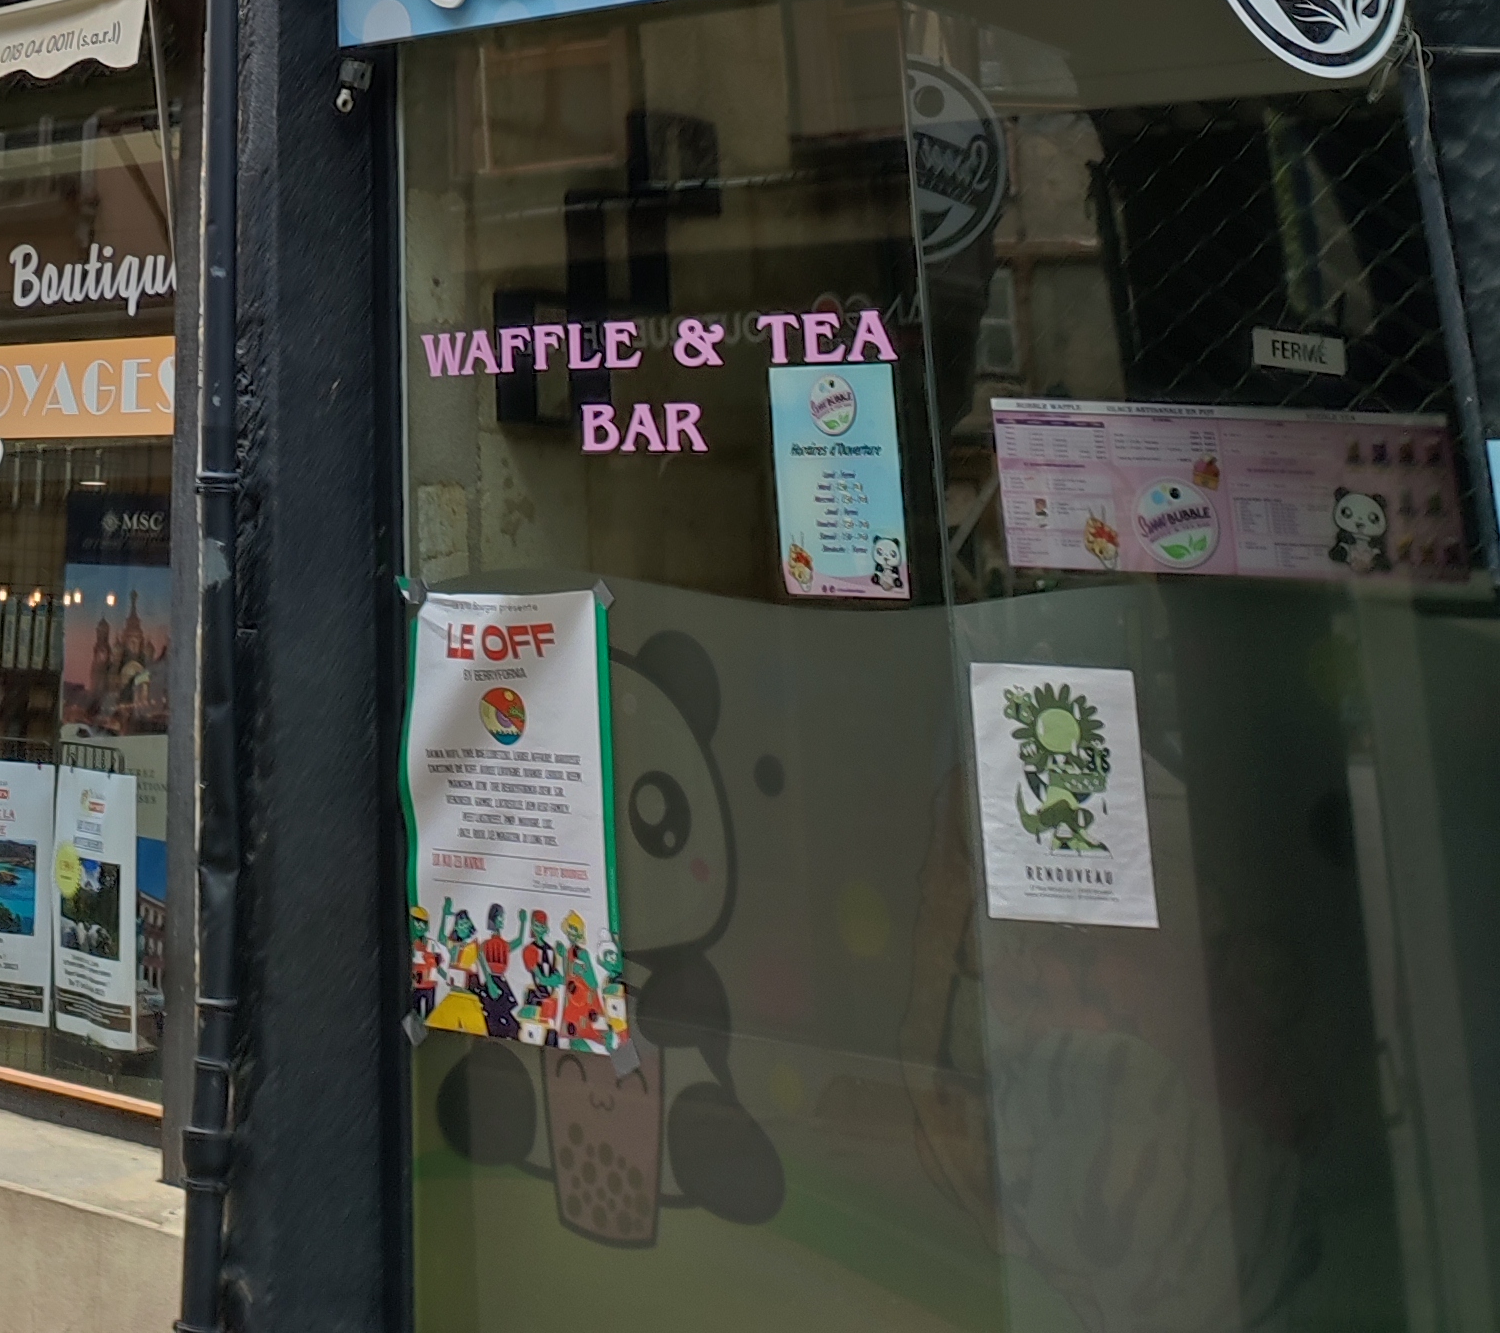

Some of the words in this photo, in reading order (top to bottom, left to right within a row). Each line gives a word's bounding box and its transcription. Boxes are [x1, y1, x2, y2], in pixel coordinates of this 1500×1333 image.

[8, 242, 177, 317] Boutiqu
[420, 319, 644, 378] WAFFLE
[672, 317, 726, 368] &
[755, 308, 900, 364] TEA
[581, 402, 709, 453] BAR
[122, 511, 165, 532] MSC
[446, 622, 476, 661] LE
[480, 622, 556, 662] OFF
[1025, 865, 1114, 886] RENOUVEAU
